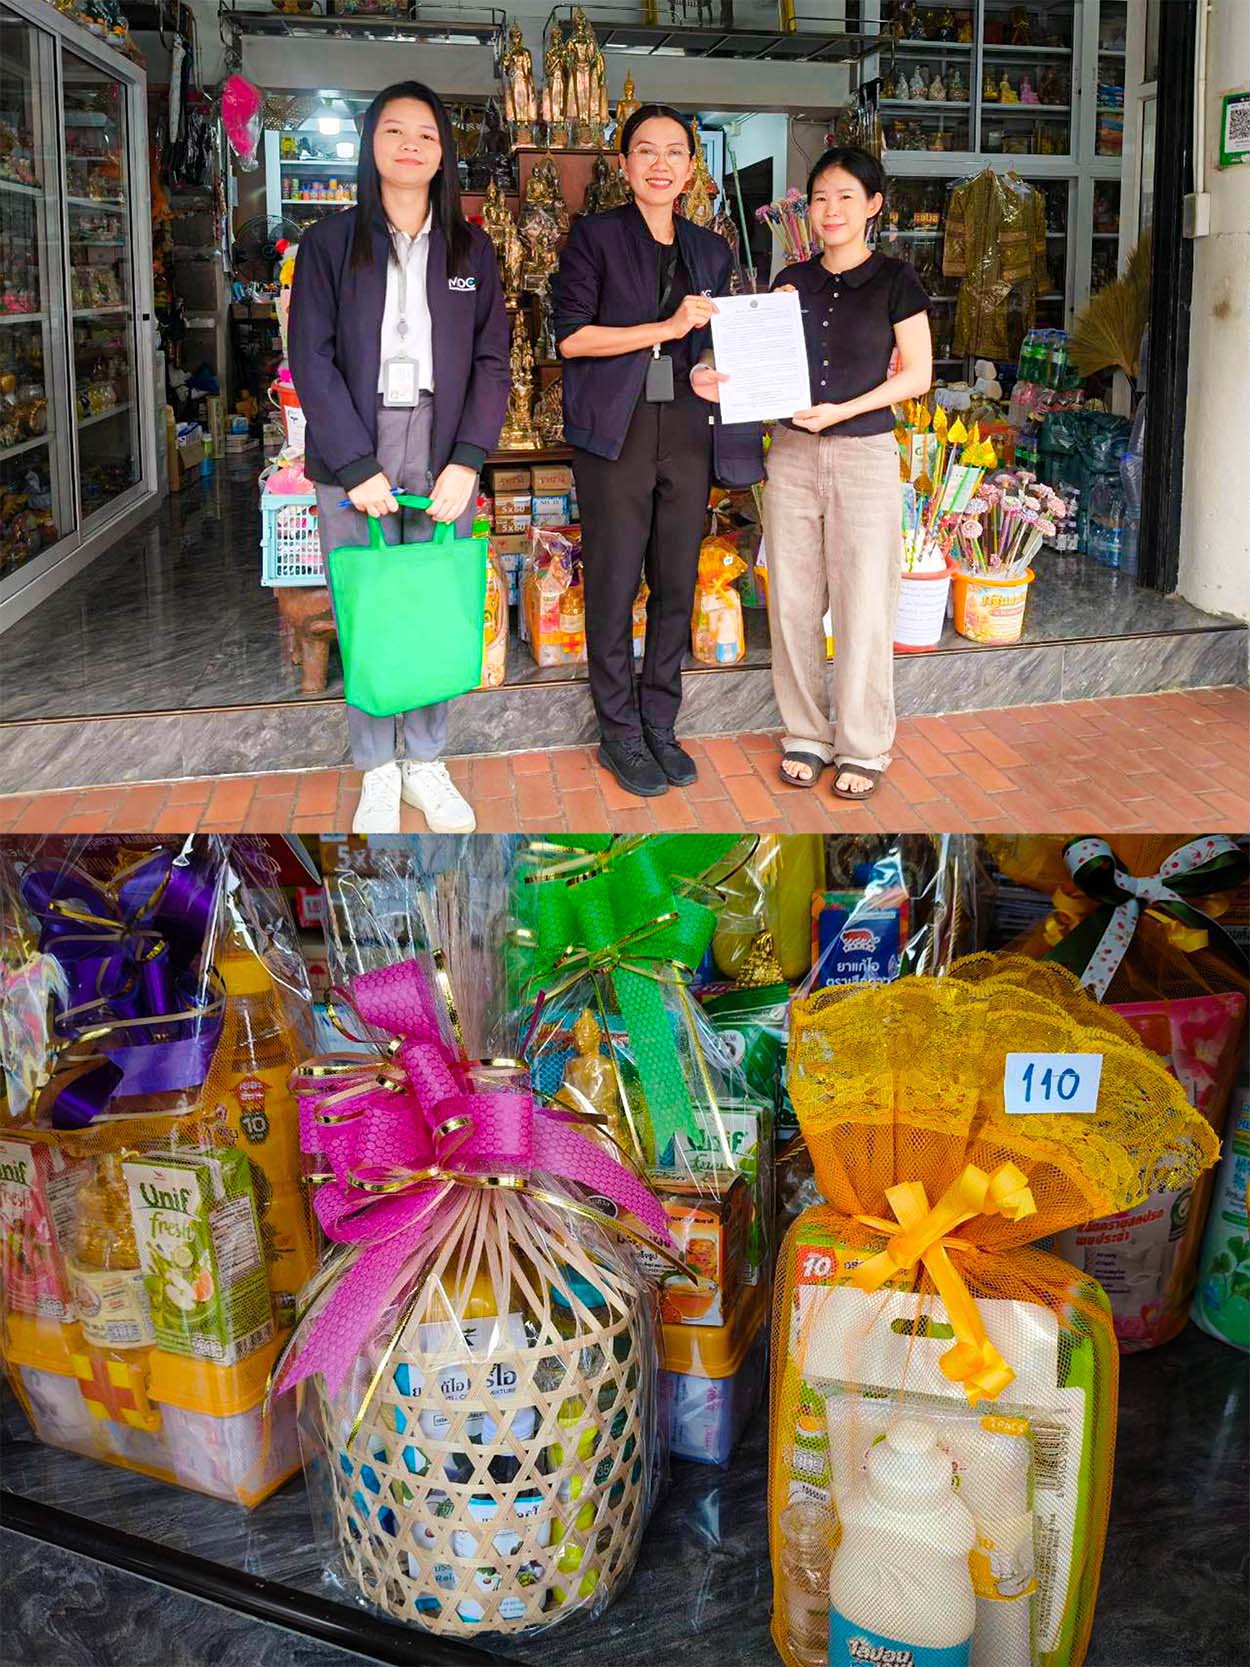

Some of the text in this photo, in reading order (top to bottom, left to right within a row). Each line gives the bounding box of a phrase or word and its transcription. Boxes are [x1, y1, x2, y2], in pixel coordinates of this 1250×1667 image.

[837, 957, 880, 973] ยาแก้ไอ
[1022, 1063, 1080, 1102] 110
[0, 1161, 28, 1187] nif
[139, 1182, 193, 1214] Unif
[802, 1252, 833, 1278] 10
